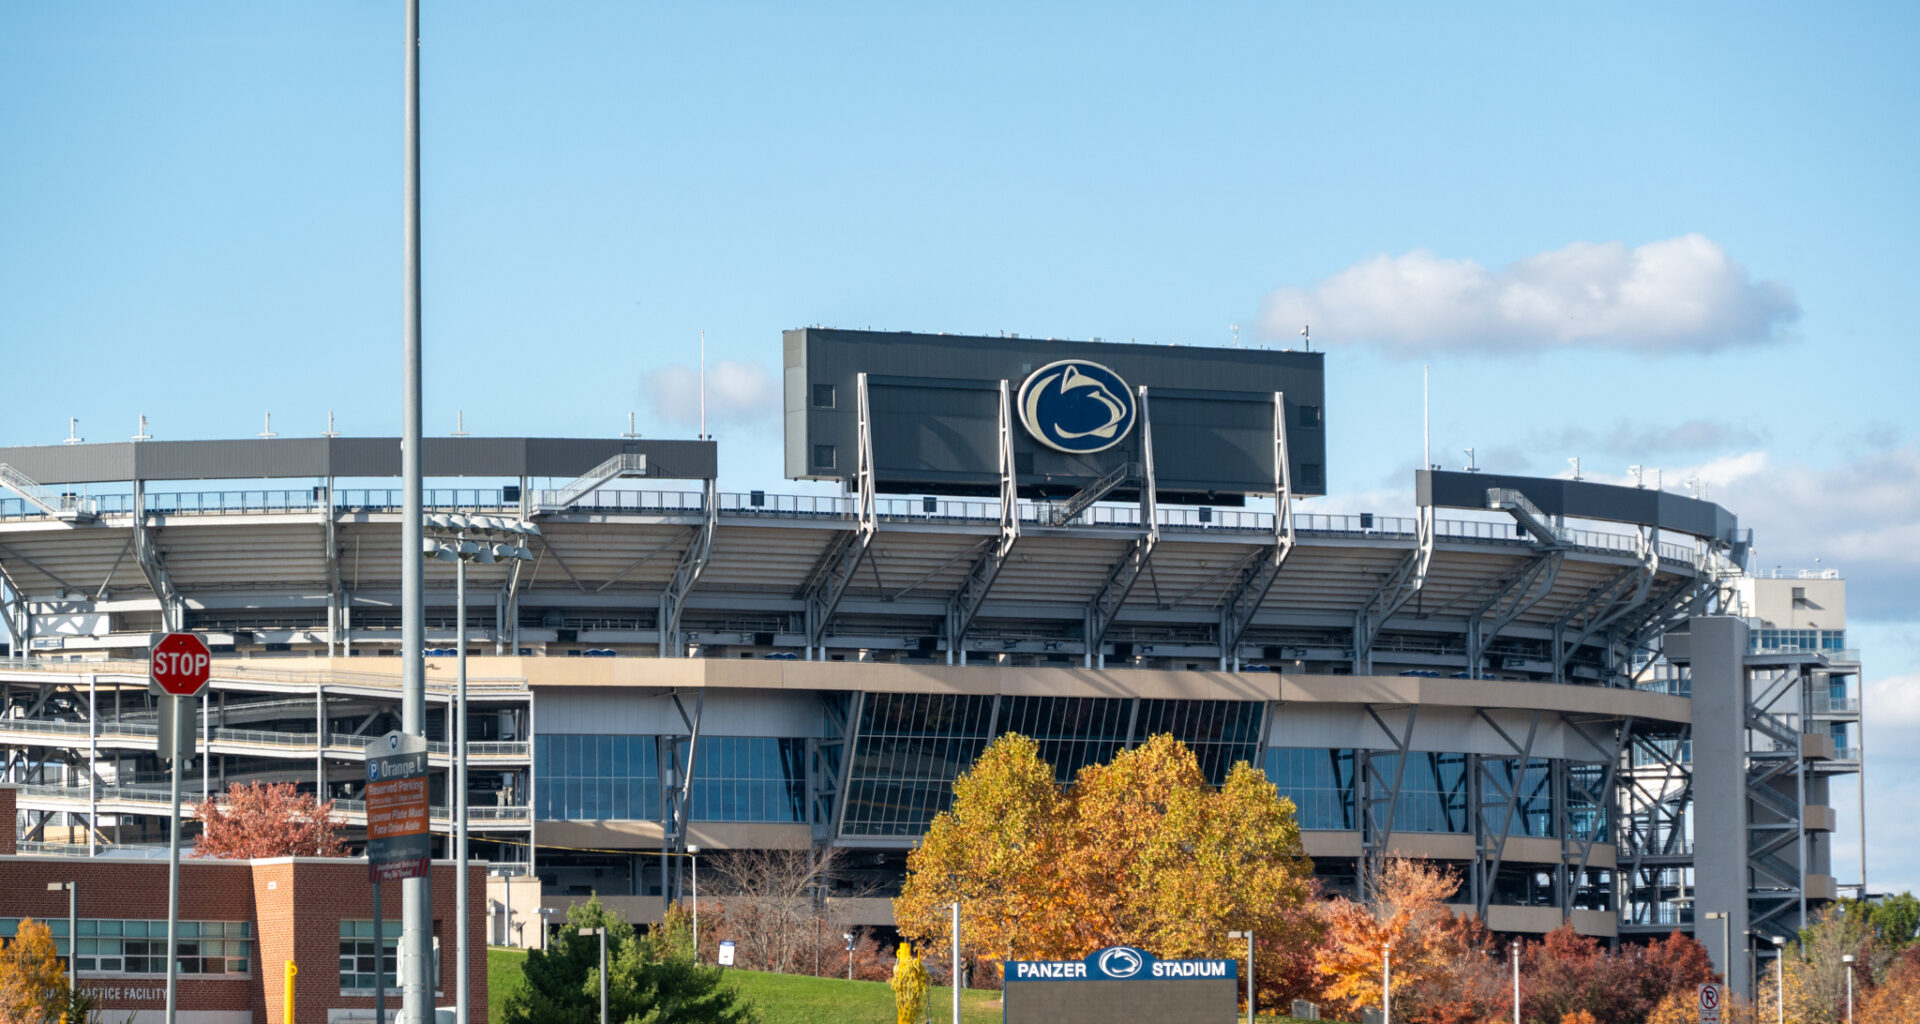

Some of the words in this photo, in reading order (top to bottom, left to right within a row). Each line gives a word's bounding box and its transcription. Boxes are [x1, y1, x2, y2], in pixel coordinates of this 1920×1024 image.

[155, 651, 208, 676] STOP
[381, 760, 415, 778] Orange
[417, 756, 423, 773] L
[368, 783, 398, 796] Reserved
[399, 780, 424, 793] Parking
[369, 812, 391, 823] License
[392, 809, 407, 820] Plate
[408, 807, 424, 818] Must
[374, 823, 387, 835] Face
[388, 822, 404, 833] Drive
[405, 820, 420, 831] Aisle
[1017, 962, 1087, 978] PANZER
[1152, 962, 1226, 977] STADIUM
[80, 987, 121, 1000] ACTICE
[124, 987, 167, 1000] FACILITY
